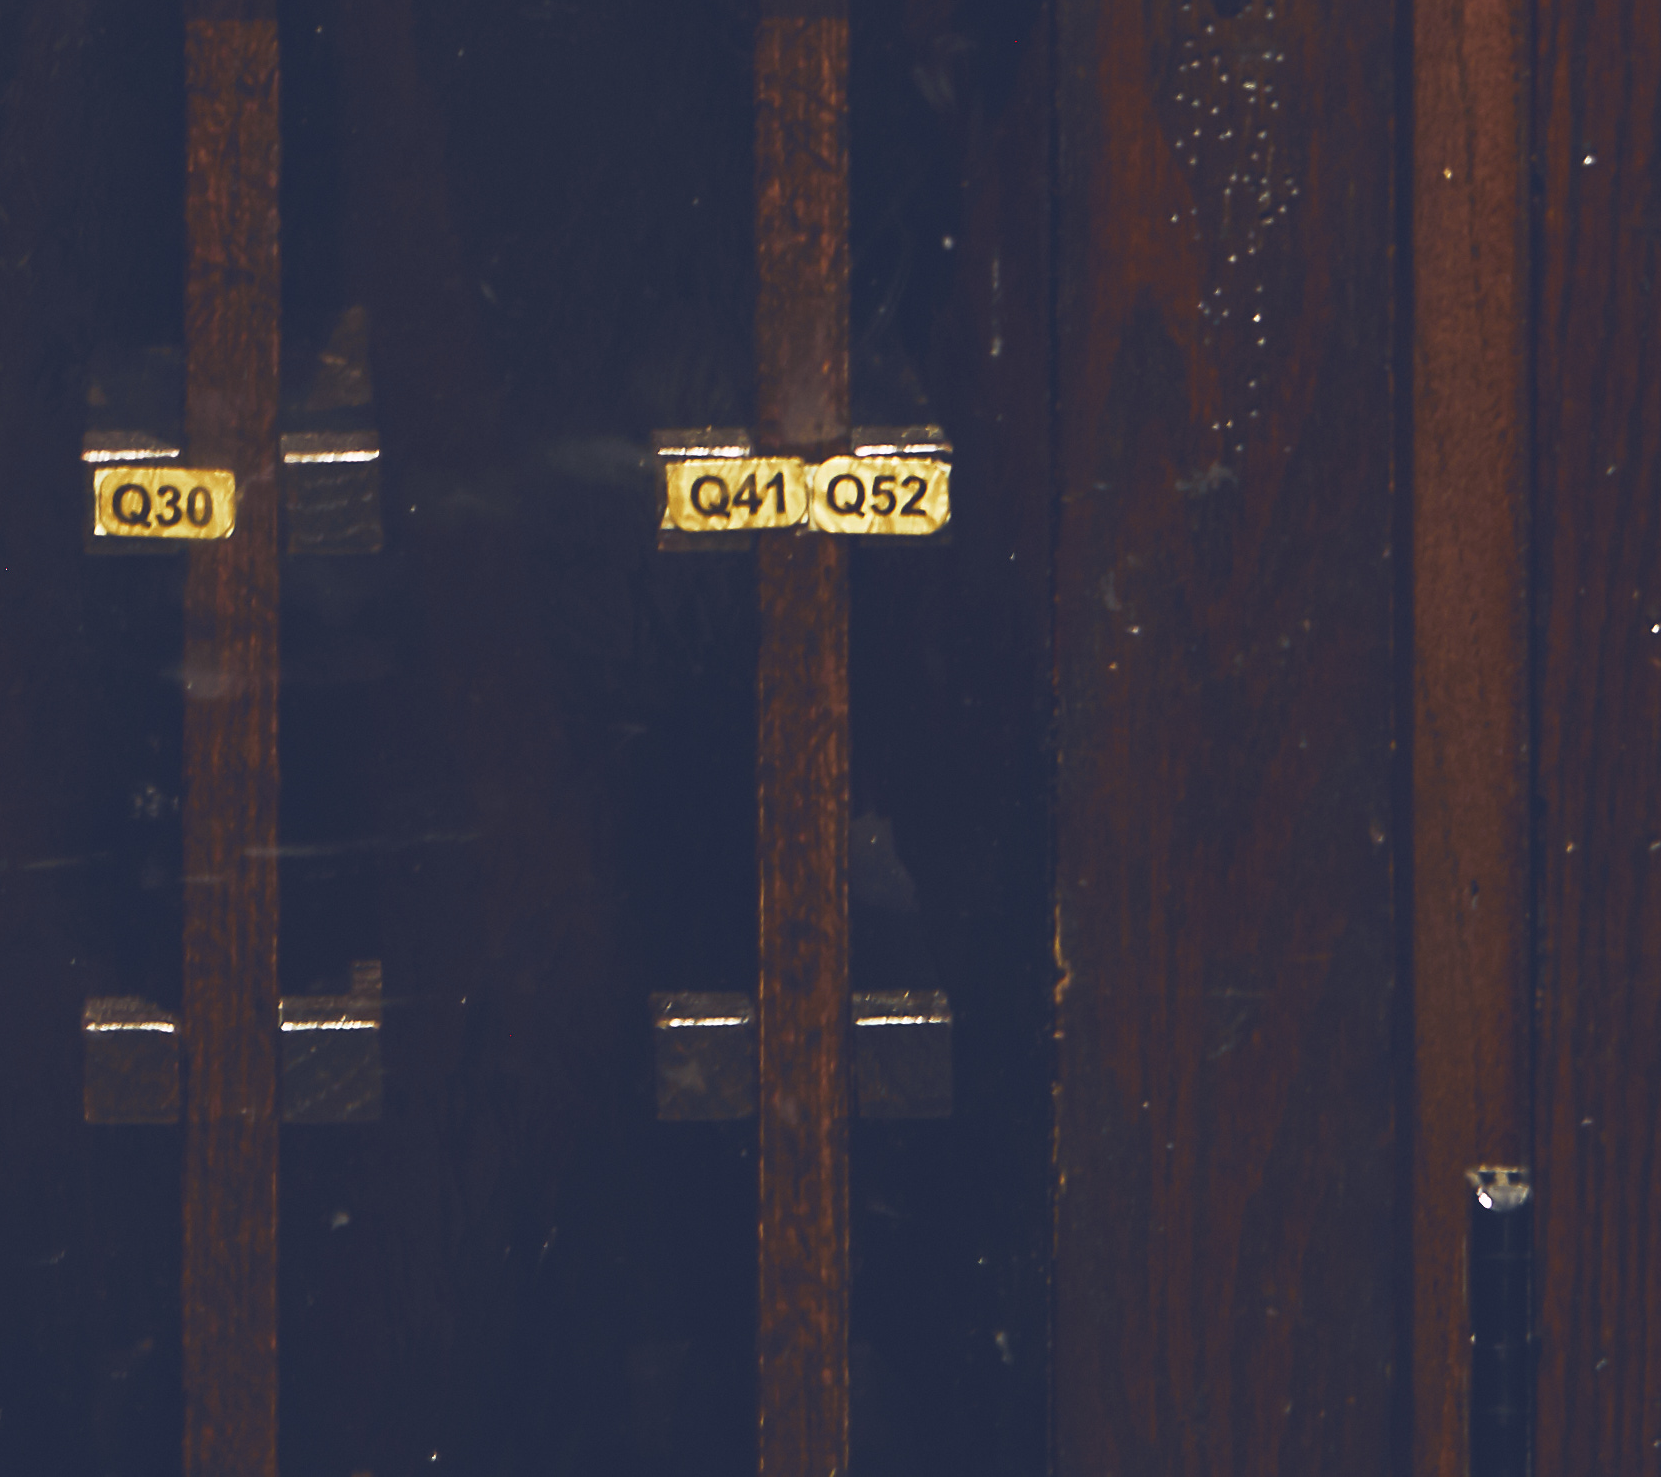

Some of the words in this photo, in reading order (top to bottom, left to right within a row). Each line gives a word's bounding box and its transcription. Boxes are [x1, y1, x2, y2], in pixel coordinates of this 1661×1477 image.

[112, 483, 212, 528] Q30
[691, 472, 785, 518] Q41
[827, 474, 927, 516] Q52
